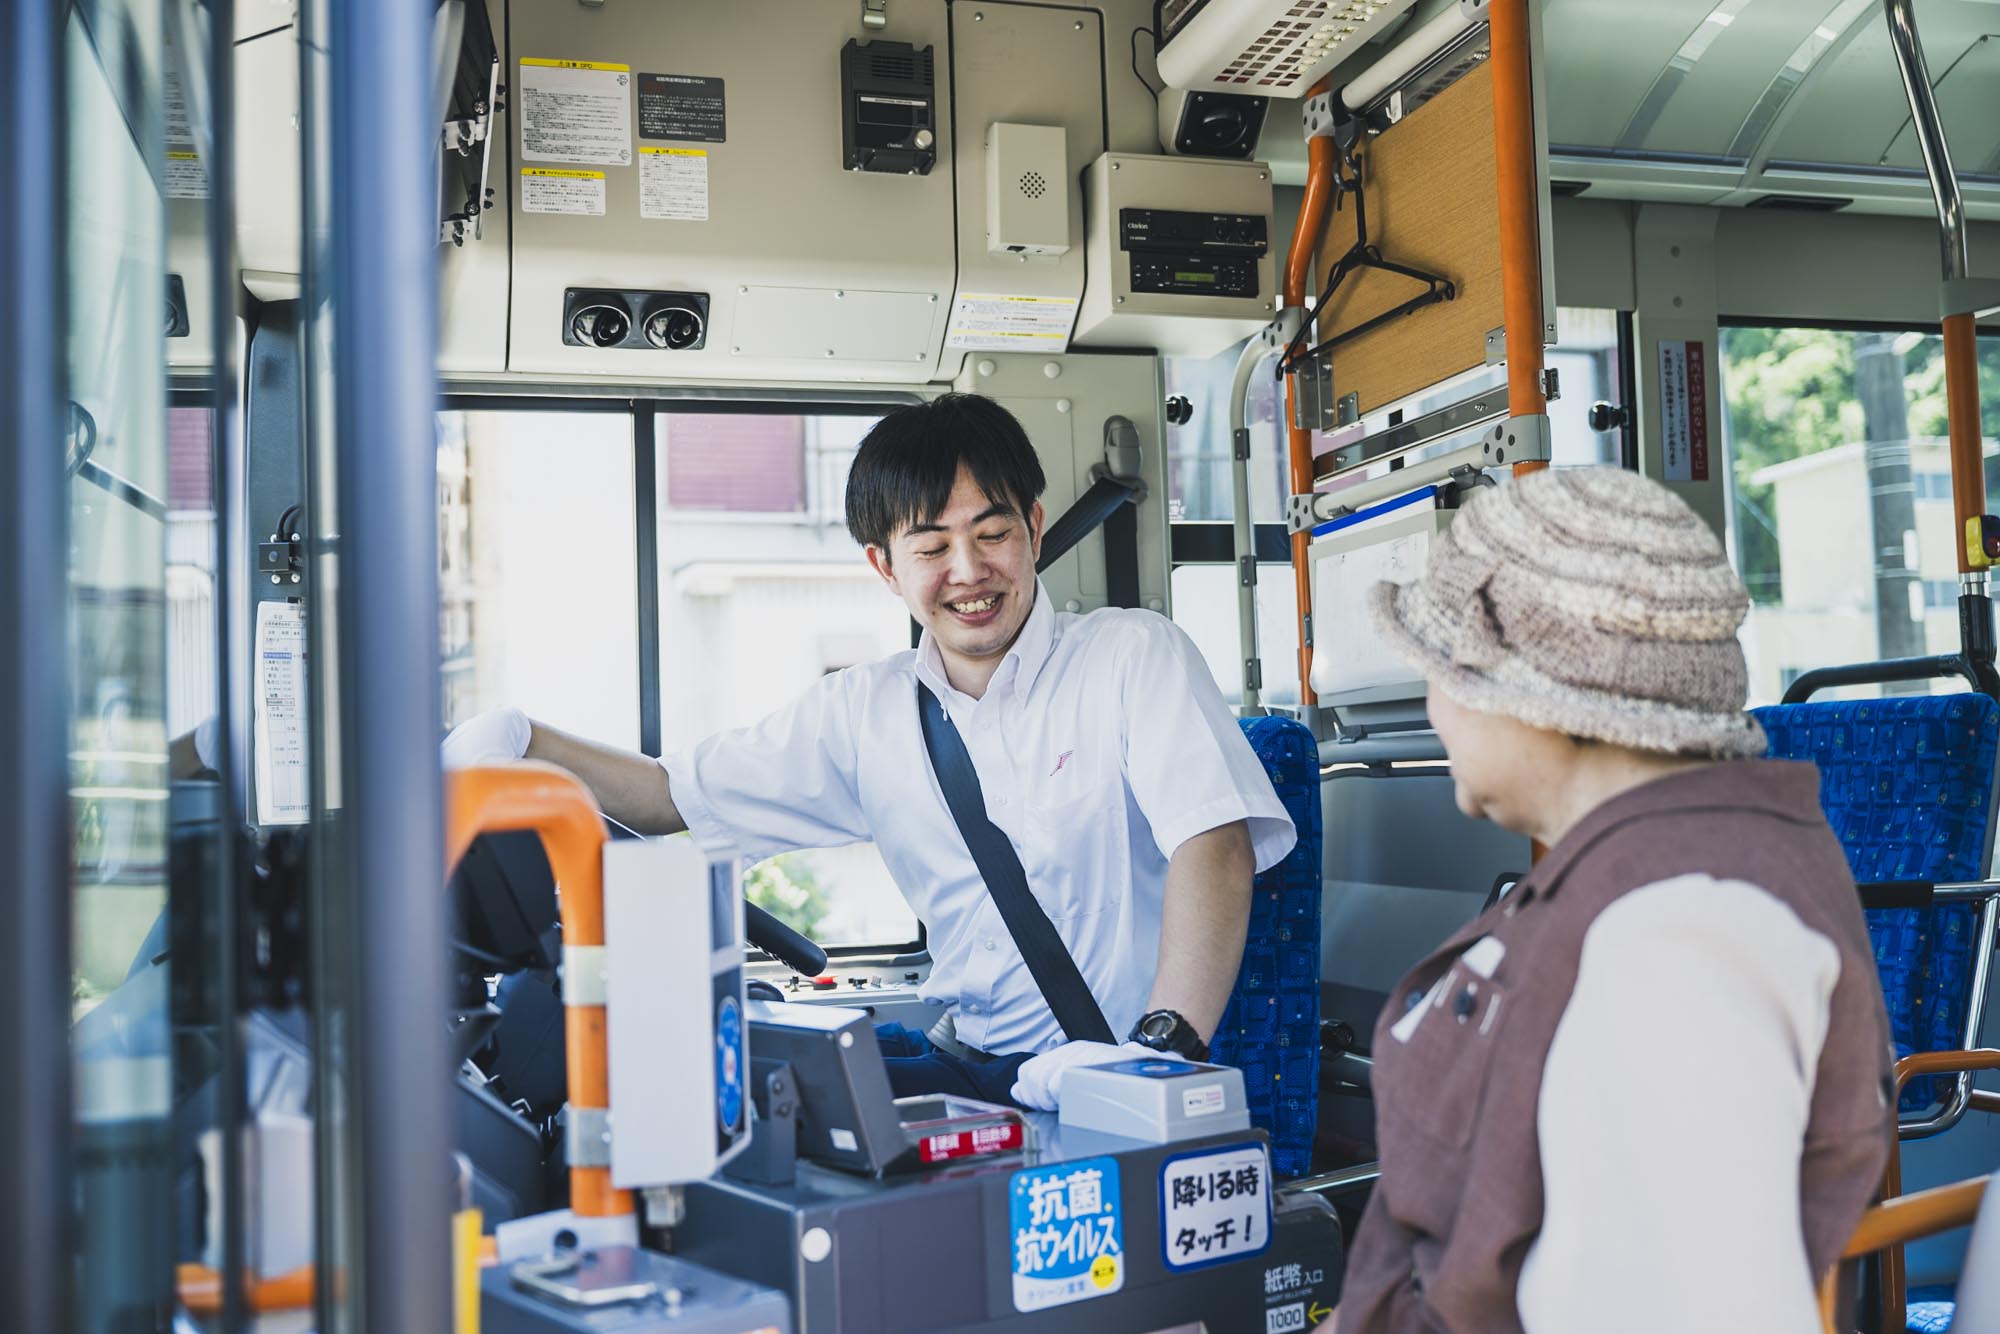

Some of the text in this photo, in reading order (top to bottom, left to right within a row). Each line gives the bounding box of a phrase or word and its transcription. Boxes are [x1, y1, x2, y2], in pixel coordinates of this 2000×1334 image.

[1028, 1168, 1103, 1226] 抗菌
[1172, 1164, 1260, 1210] 降りる時
[1015, 1215, 1120, 1274] 抗ウイルス
[1264, 1263, 1323, 1294] 紙幣 入口
[1269, 1308, 1302, 1330] 1000
